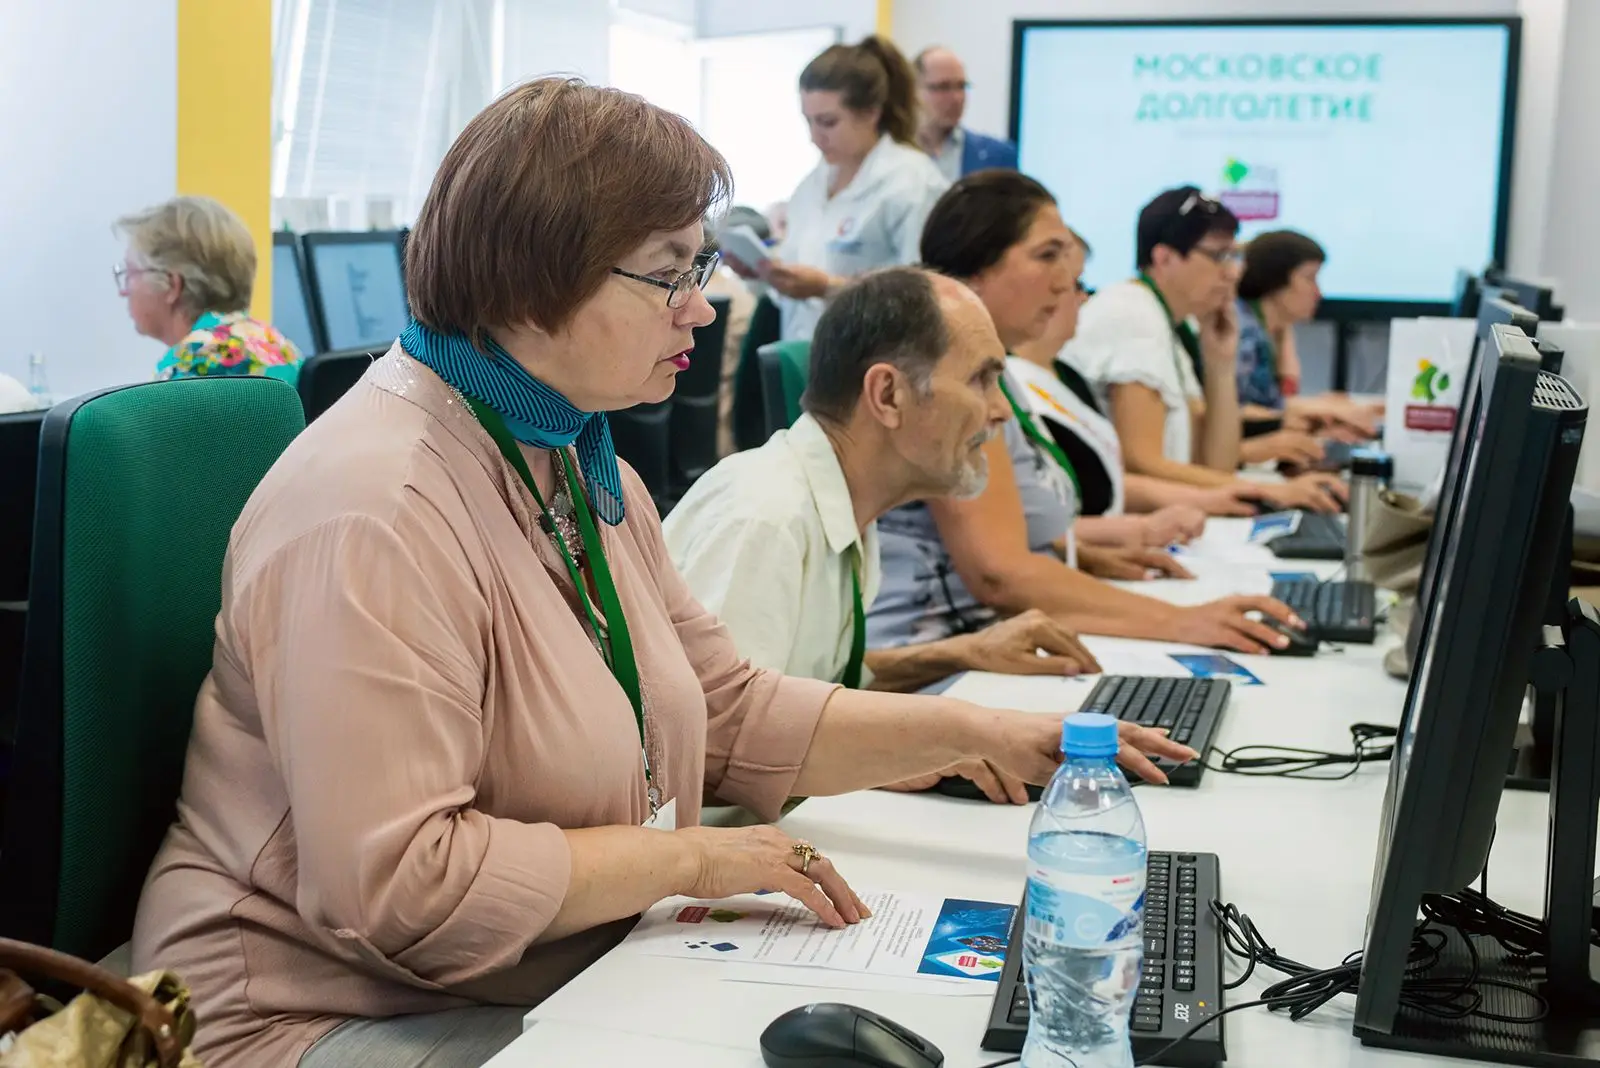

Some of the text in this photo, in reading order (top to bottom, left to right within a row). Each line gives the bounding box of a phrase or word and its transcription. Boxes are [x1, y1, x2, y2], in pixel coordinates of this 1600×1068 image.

[1134, 53, 1382, 82] МОСКОВСКОЕ
[1134, 92, 1376, 122] ДОЛГОЛЕТИЕ
[1174, 1003, 1189, 1023] acer
